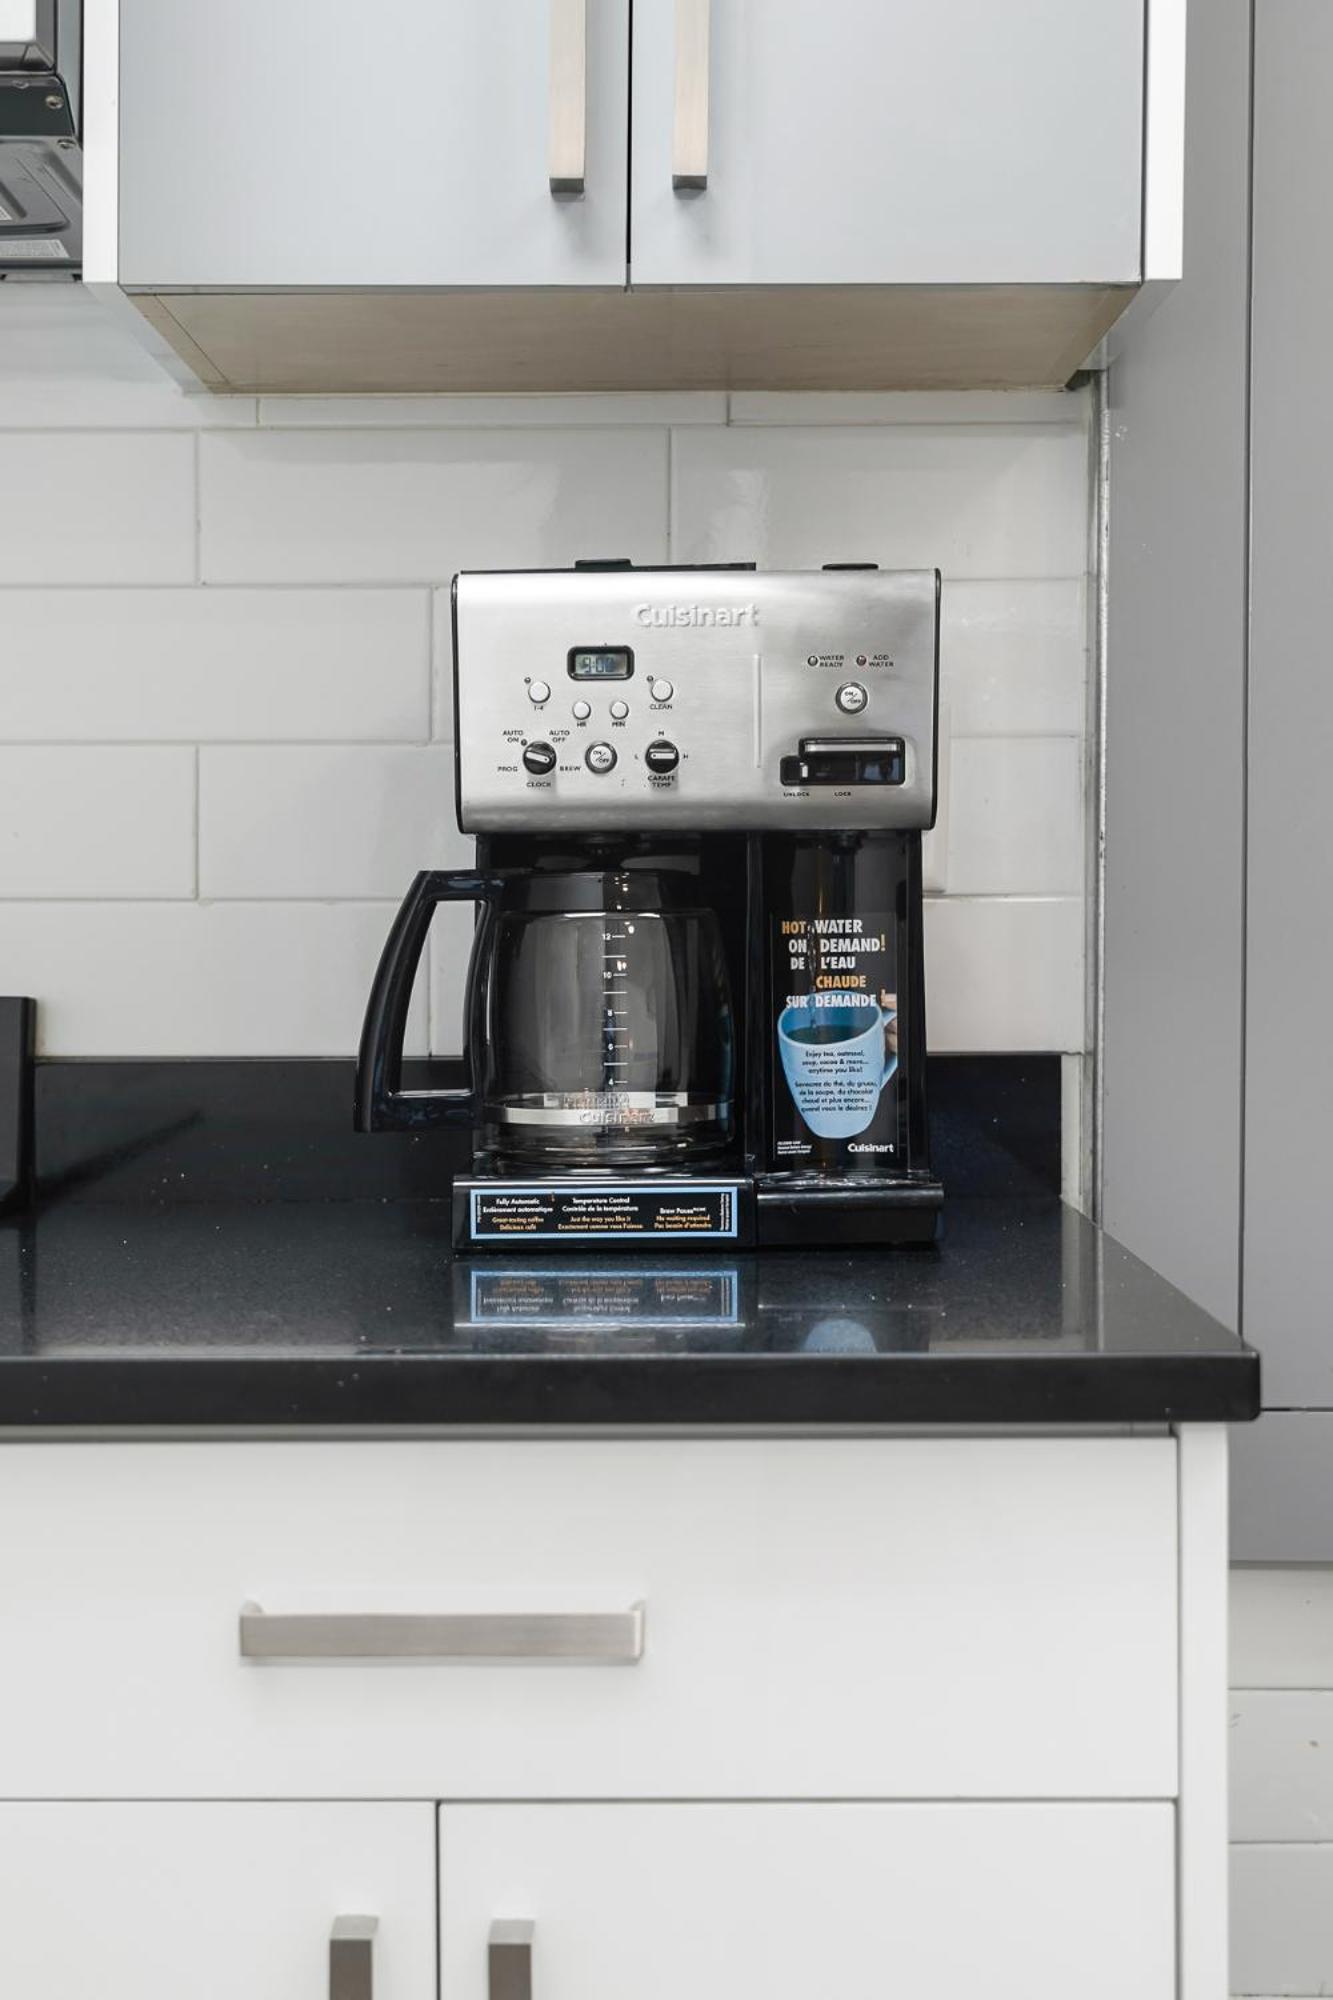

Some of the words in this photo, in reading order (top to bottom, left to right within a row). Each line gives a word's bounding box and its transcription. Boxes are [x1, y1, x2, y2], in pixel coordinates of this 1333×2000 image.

[637, 603, 760, 628] Cuisinart
[782, 921, 807, 934] HOT
[814, 919, 863, 934] WATER
[601, 933, 611, 941] 12
[788, 939, 807, 953] ON
[820, 934, 886, 953] DEMAND!
[790, 957, 805, 970] DE
[821, 956, 856, 969] L'EAU
[603, 971, 612, 979] 10
[815, 975, 866, 989] CHAUDE
[786, 995, 808, 1009] SUR
[607, 1008, 613, 1017] 8
[607, 1043, 614, 1051] 6
[608, 1078, 614, 1086] 4
[847, 1143, 894, 1153] Cuisinart
